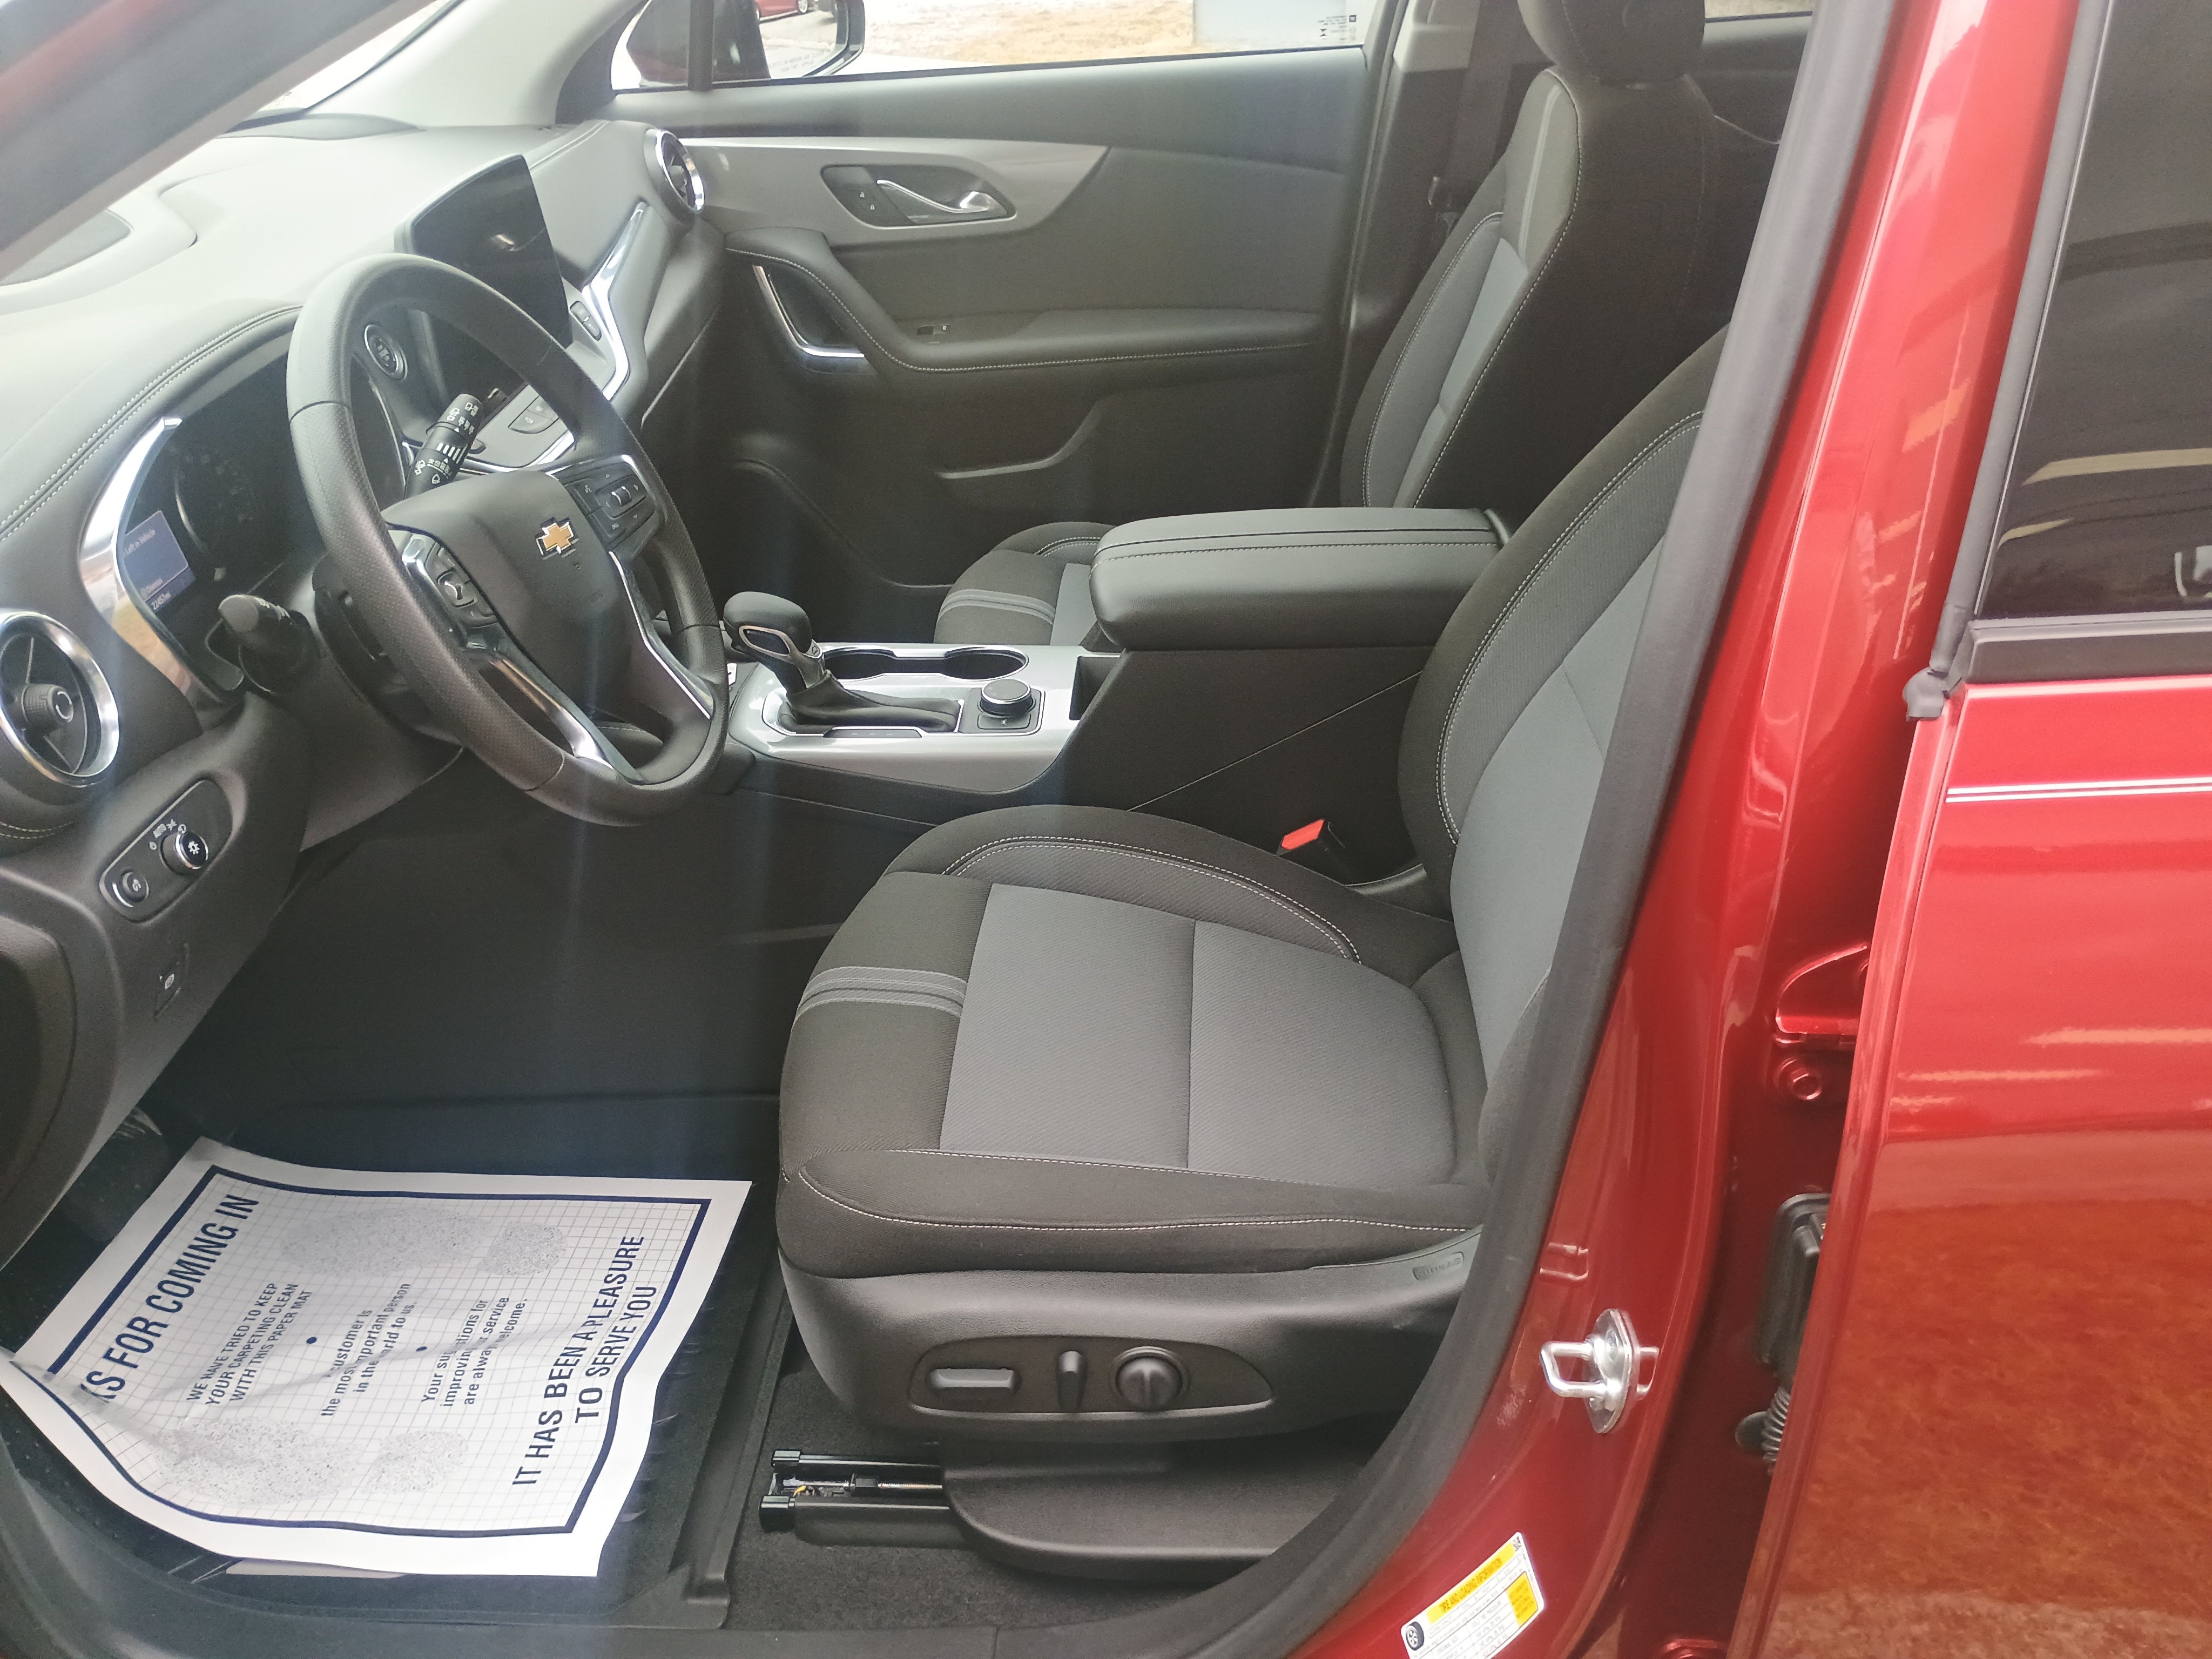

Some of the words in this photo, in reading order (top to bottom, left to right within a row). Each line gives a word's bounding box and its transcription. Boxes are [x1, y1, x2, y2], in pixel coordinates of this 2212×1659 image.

[103, 1317, 170, 1368] FOR
[146, 1223, 239, 1313] COMING
[215, 1195, 259, 1219] IN
[585, 1236, 644, 1326] PLEASURE
[624, 1287, 657, 1320] YOU
[186, 1383, 208, 1400] WE
[200, 1356, 228, 1379] HAVE
[221, 1325, 250, 1353] TRIED
[243, 1310, 261, 1322] TO
[254, 1283, 278, 1306] KEEP
[483, 1297, 509, 1334] service
[572, 1325, 597, 1341] A
[205, 1372, 235, 1404] YOUR
[228, 1317, 276, 1368] CARPETING
[269, 1284, 299, 1313] CLEAN
[230, 1369, 257, 1401] WITH
[248, 1344, 274, 1365] THIS
[268, 1312, 298, 1341] PAPER
[291, 1291, 313, 1309] MAT
[321, 1399, 340, 1415] the
[355, 1314, 388, 1363] portant
[384, 1284, 410, 1312] person
[353, 1382, 369, 1392] in
[361, 1360, 379, 1377] the
[391, 1318, 406, 1327] to
[421, 1373, 443, 1402] Your
[470, 1300, 488, 1311] for
[585, 1326, 637, 1376] SERVE
[464, 1384, 479, 1404] are
[544, 1346, 587, 1398] BEEN
[575, 1387, 603, 1423] TO
[525, 1410, 563, 1458] HAS
[512, 1466, 542, 1485] IT
